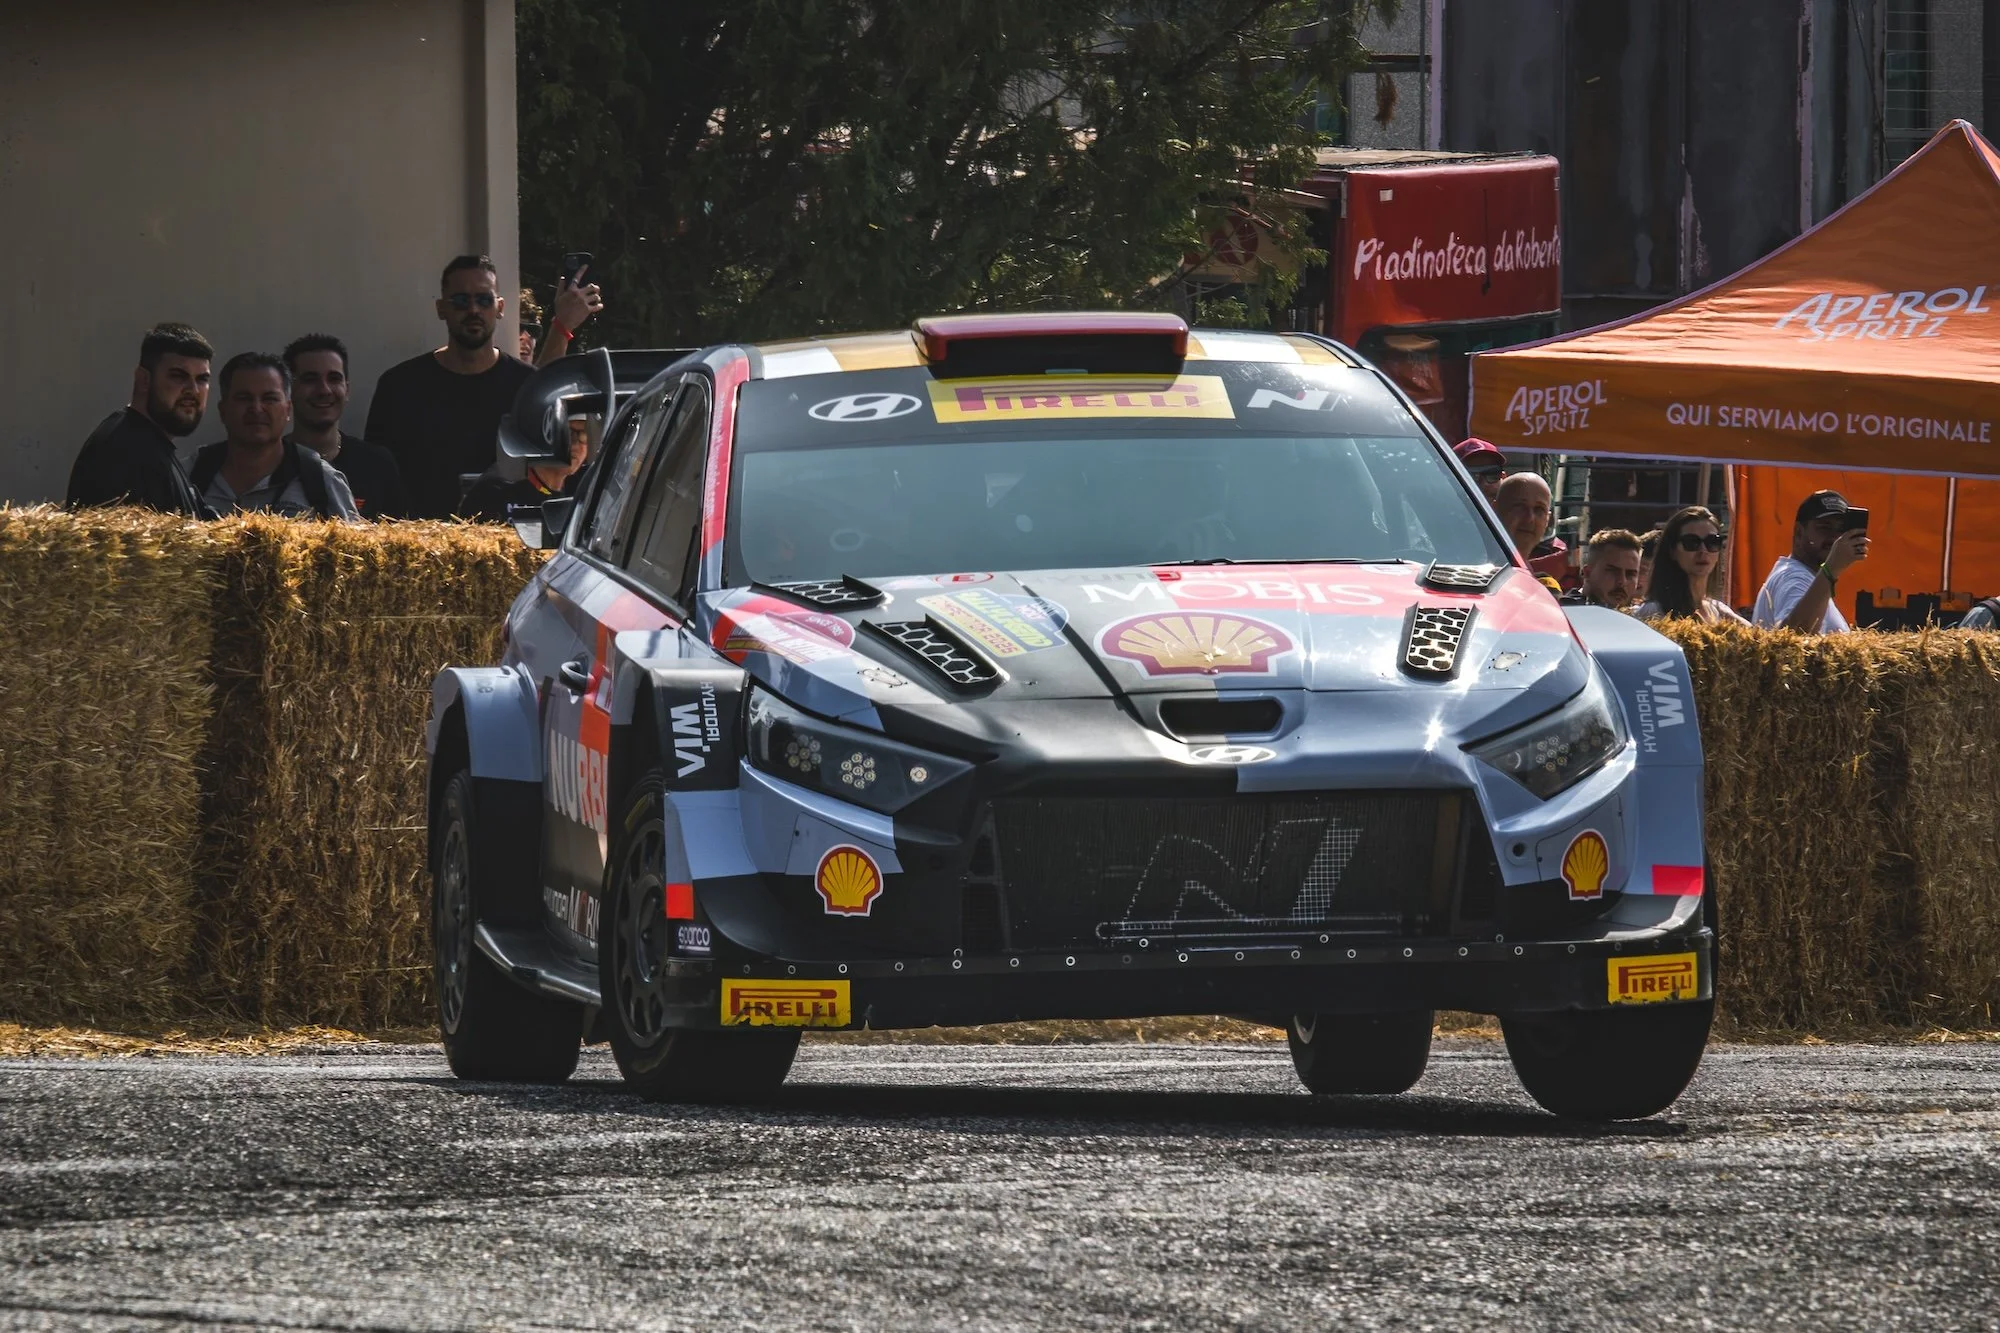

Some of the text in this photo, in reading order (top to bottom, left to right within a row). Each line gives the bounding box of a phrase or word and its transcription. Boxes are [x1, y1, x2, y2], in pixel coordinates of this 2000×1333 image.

[1354, 232, 1486, 281] Piadinoteca
[1771, 286, 1990, 330] APEROL
[955, 383, 1199, 412] PIRELLI
[1504, 380, 1607, 421] APEROL
[1666, 403, 1991, 443] QUI SERVIAMO L'ORIGINALE
[1081, 579, 1385, 606] MOBIS
[700, 681, 720, 741] HYUNDAI
[1635, 690, 1658, 753] HYUNDAI
[1618, 961, 1692, 994] PIRELLI
[730, 988, 837, 1017] PIRELLI
